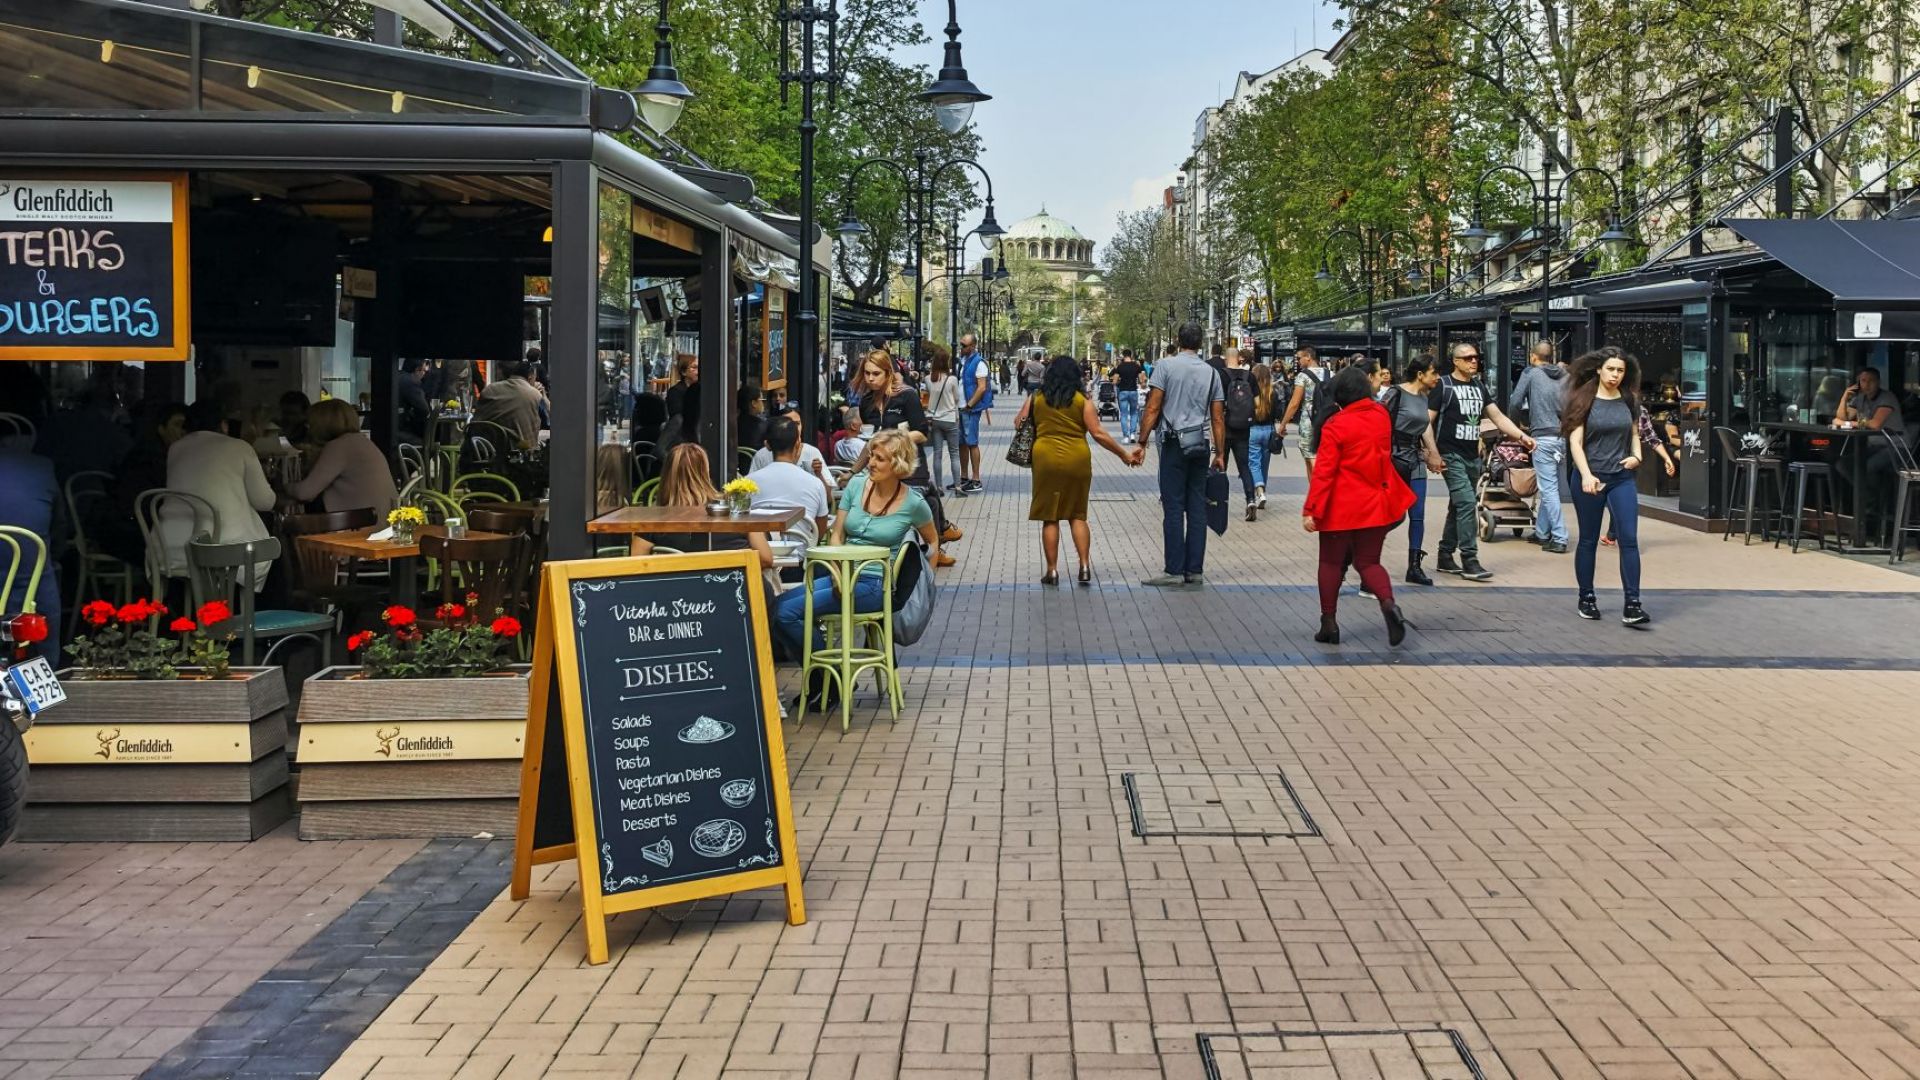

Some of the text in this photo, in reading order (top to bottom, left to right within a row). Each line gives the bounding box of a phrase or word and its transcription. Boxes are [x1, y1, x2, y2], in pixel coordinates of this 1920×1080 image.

[14, 187, 113, 212] Glenfiddich
[37, 269, 56, 295] &
[609, 598, 716, 621] Vitosha Street
[629, 621, 703, 643] BAR & DINNER
[623, 660, 715, 689] DISHES:
[32, 680, 62, 704] 3729
[611, 714, 652, 730] Salads
[116, 739, 172, 753] Glenfiddich
[397, 736, 453, 751] Glenfiddich
[613, 735, 650, 751] Soups
[616, 756, 651, 771] Pasta
[618, 767, 722, 794] Vegetarian Dishes
[620, 791, 691, 812] Meat Dishes
[622, 813, 678, 832] Desserts
